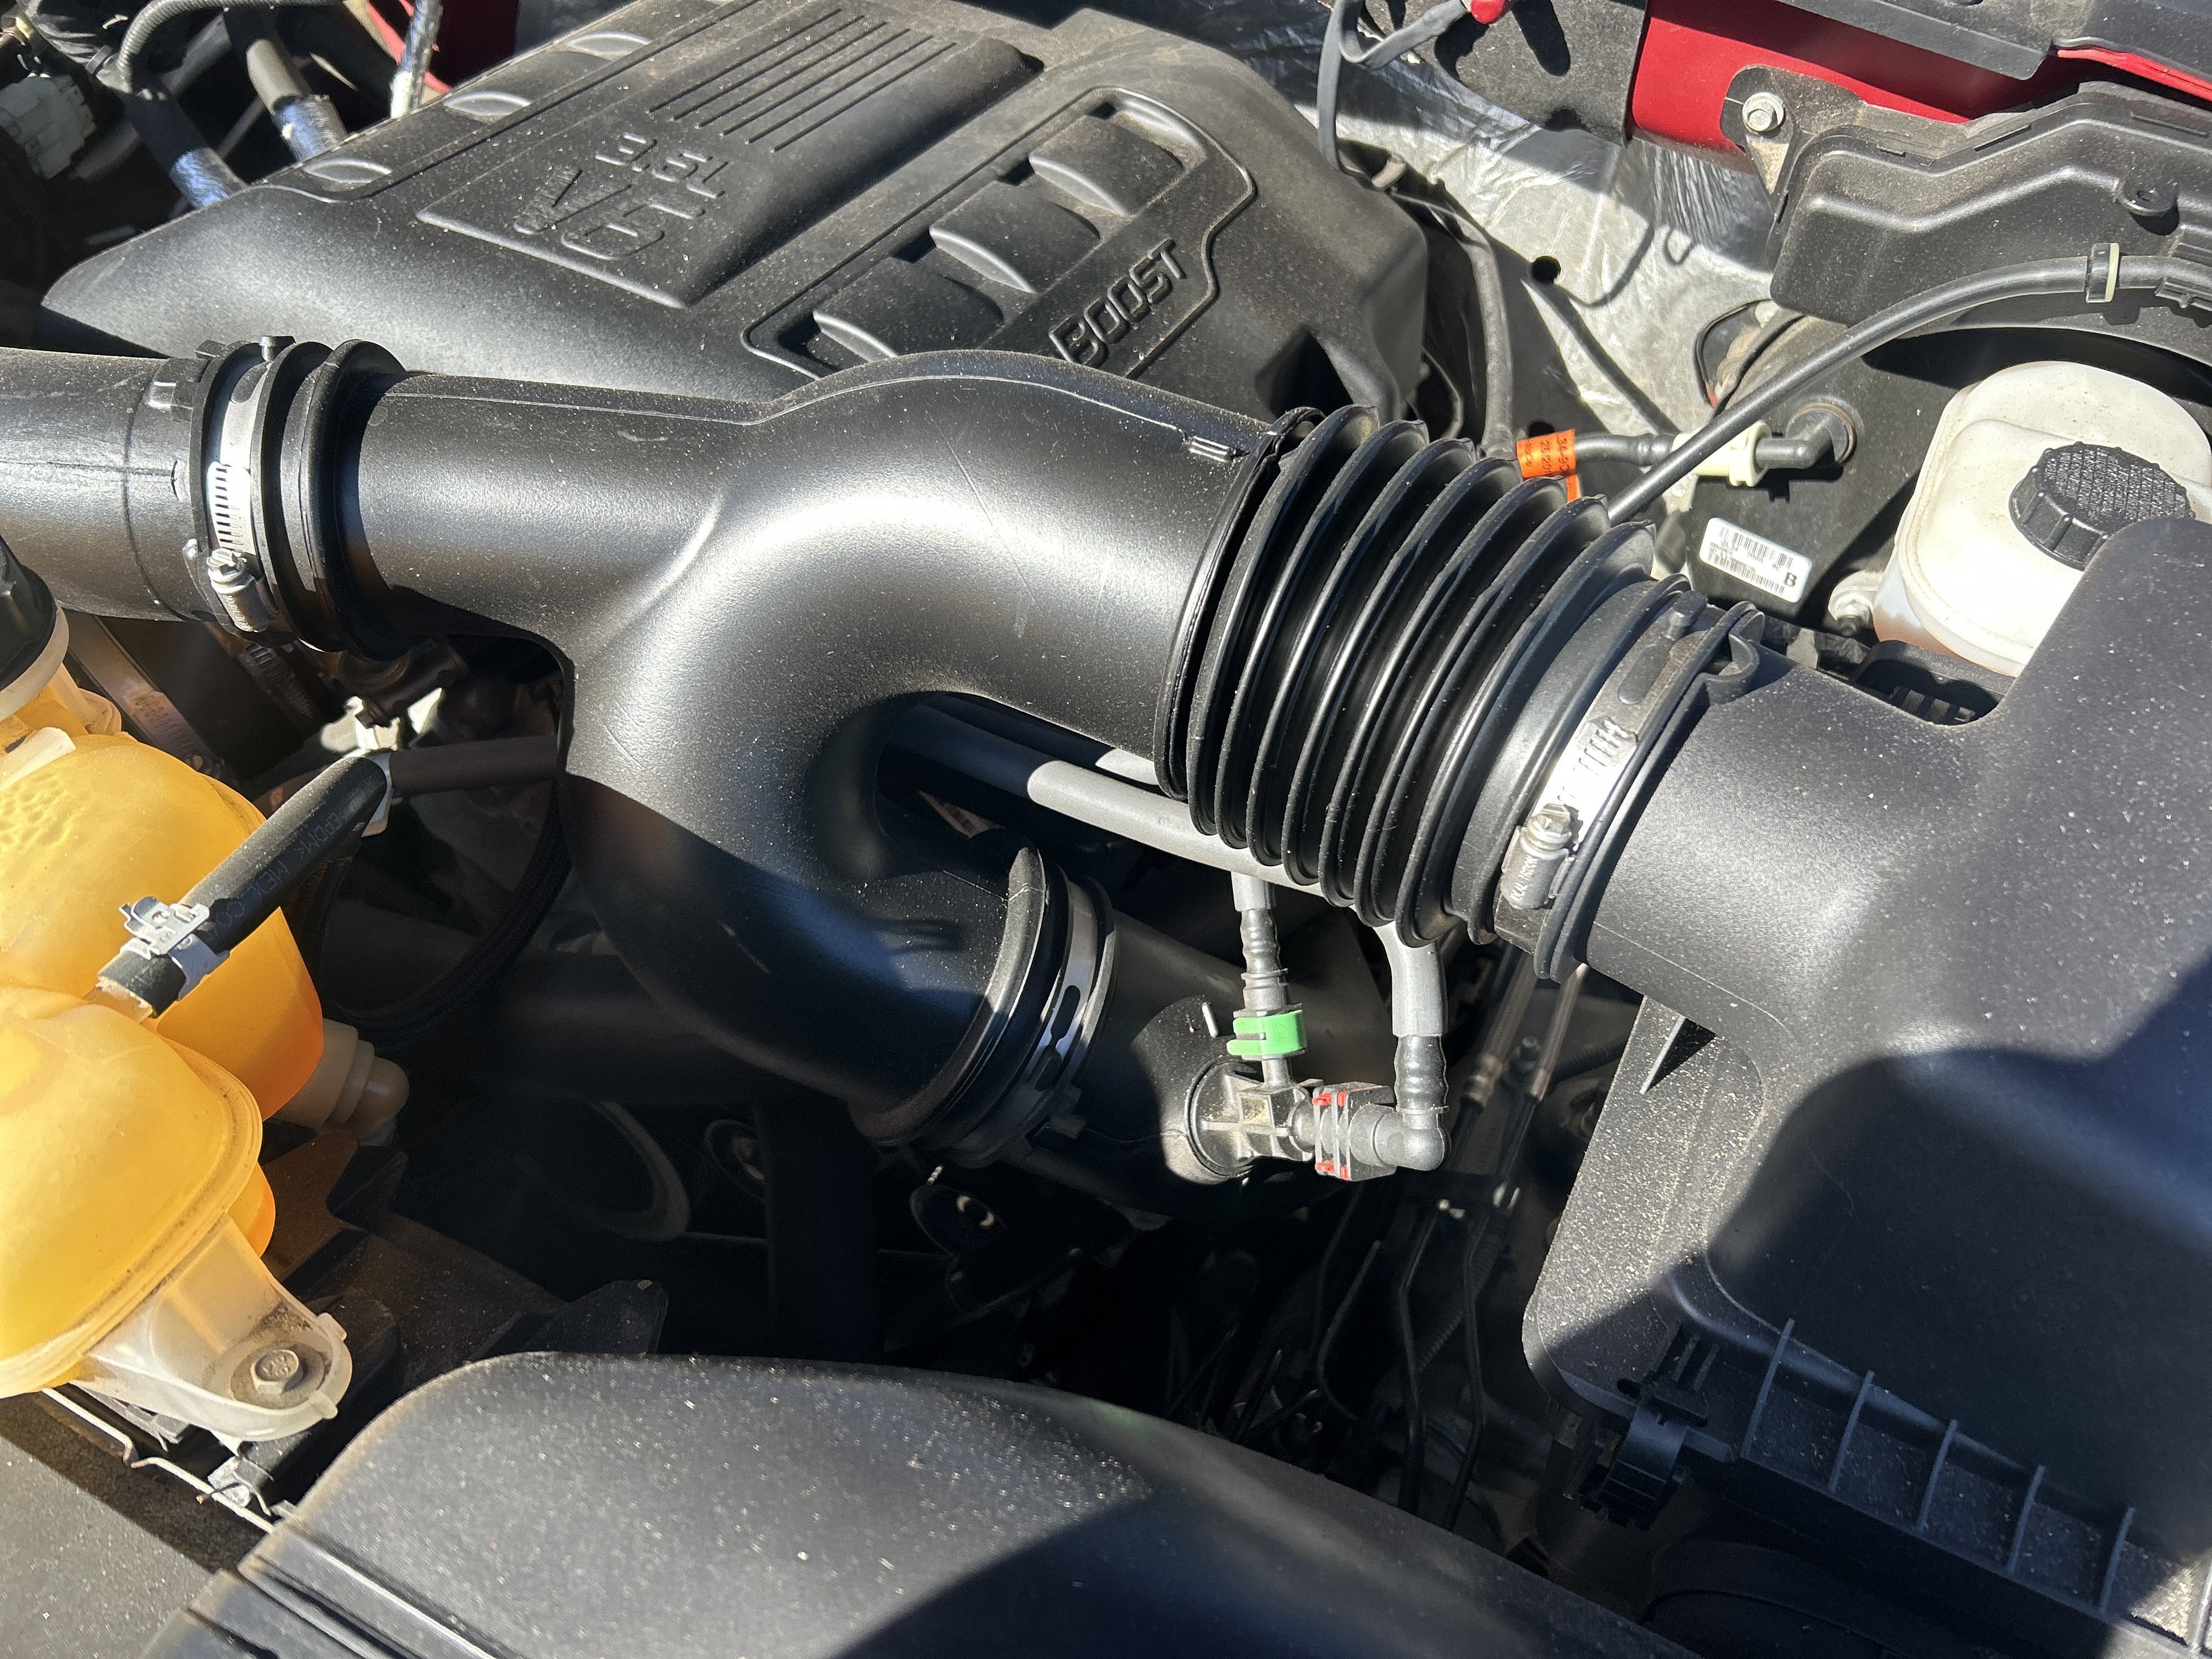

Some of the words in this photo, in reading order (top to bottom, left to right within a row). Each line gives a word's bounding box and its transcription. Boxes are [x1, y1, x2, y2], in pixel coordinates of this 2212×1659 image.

[513, 163, 707, 261] V6
[1048, 238, 1187, 369] BOOST
[1783, 572, 1798, 587] B
